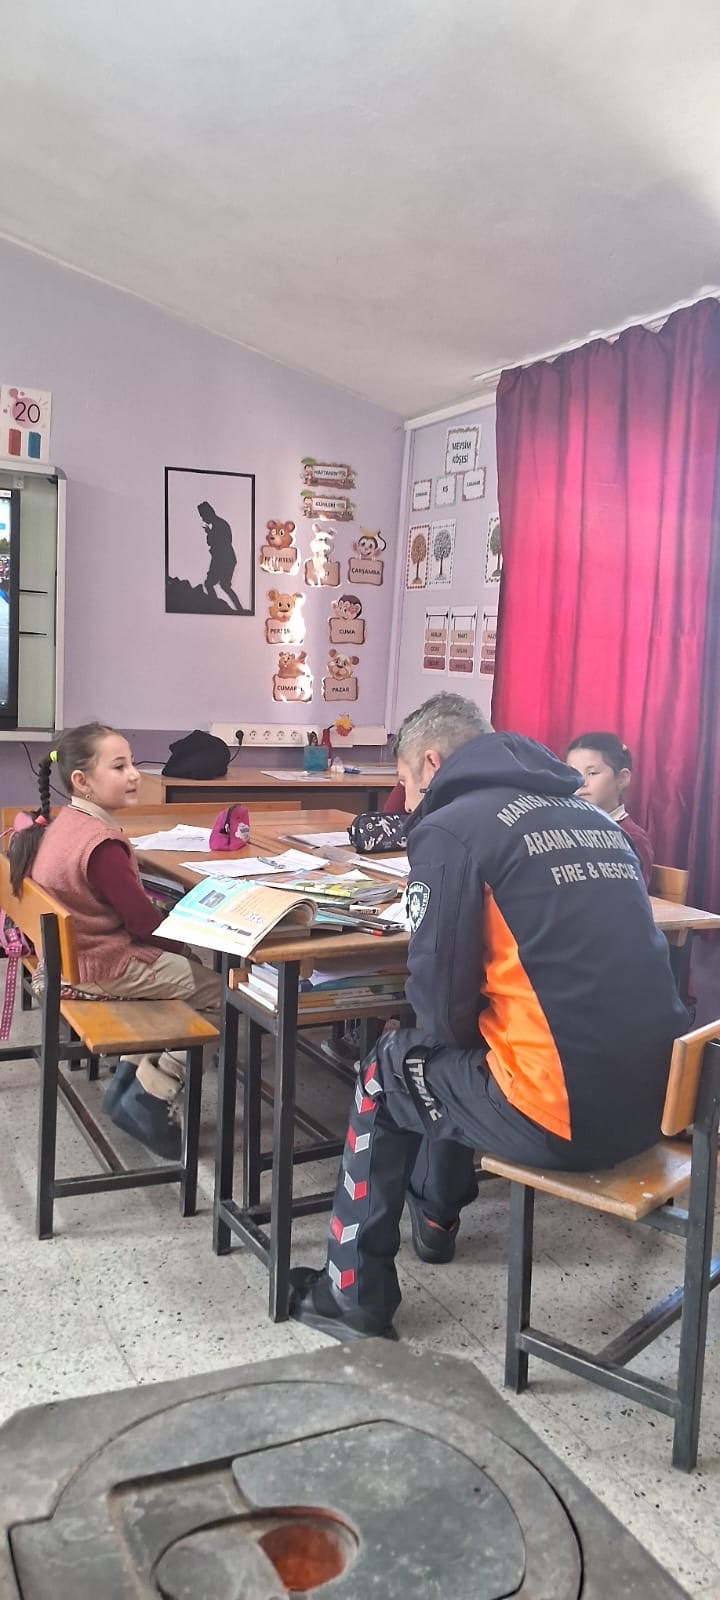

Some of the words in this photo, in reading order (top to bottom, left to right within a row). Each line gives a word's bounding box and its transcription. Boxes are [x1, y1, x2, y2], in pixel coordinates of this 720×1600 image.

[15, 401, 41, 424] 20
[452, 440, 472, 451] MEVSİM
[497, 794, 550, 827] MANİSA
[523, 830, 577, 856] ARAMA
[551, 863, 587, 885] FIRE
[587, 863, 600, 879] &
[600, 862, 639, 880] RESCUE
